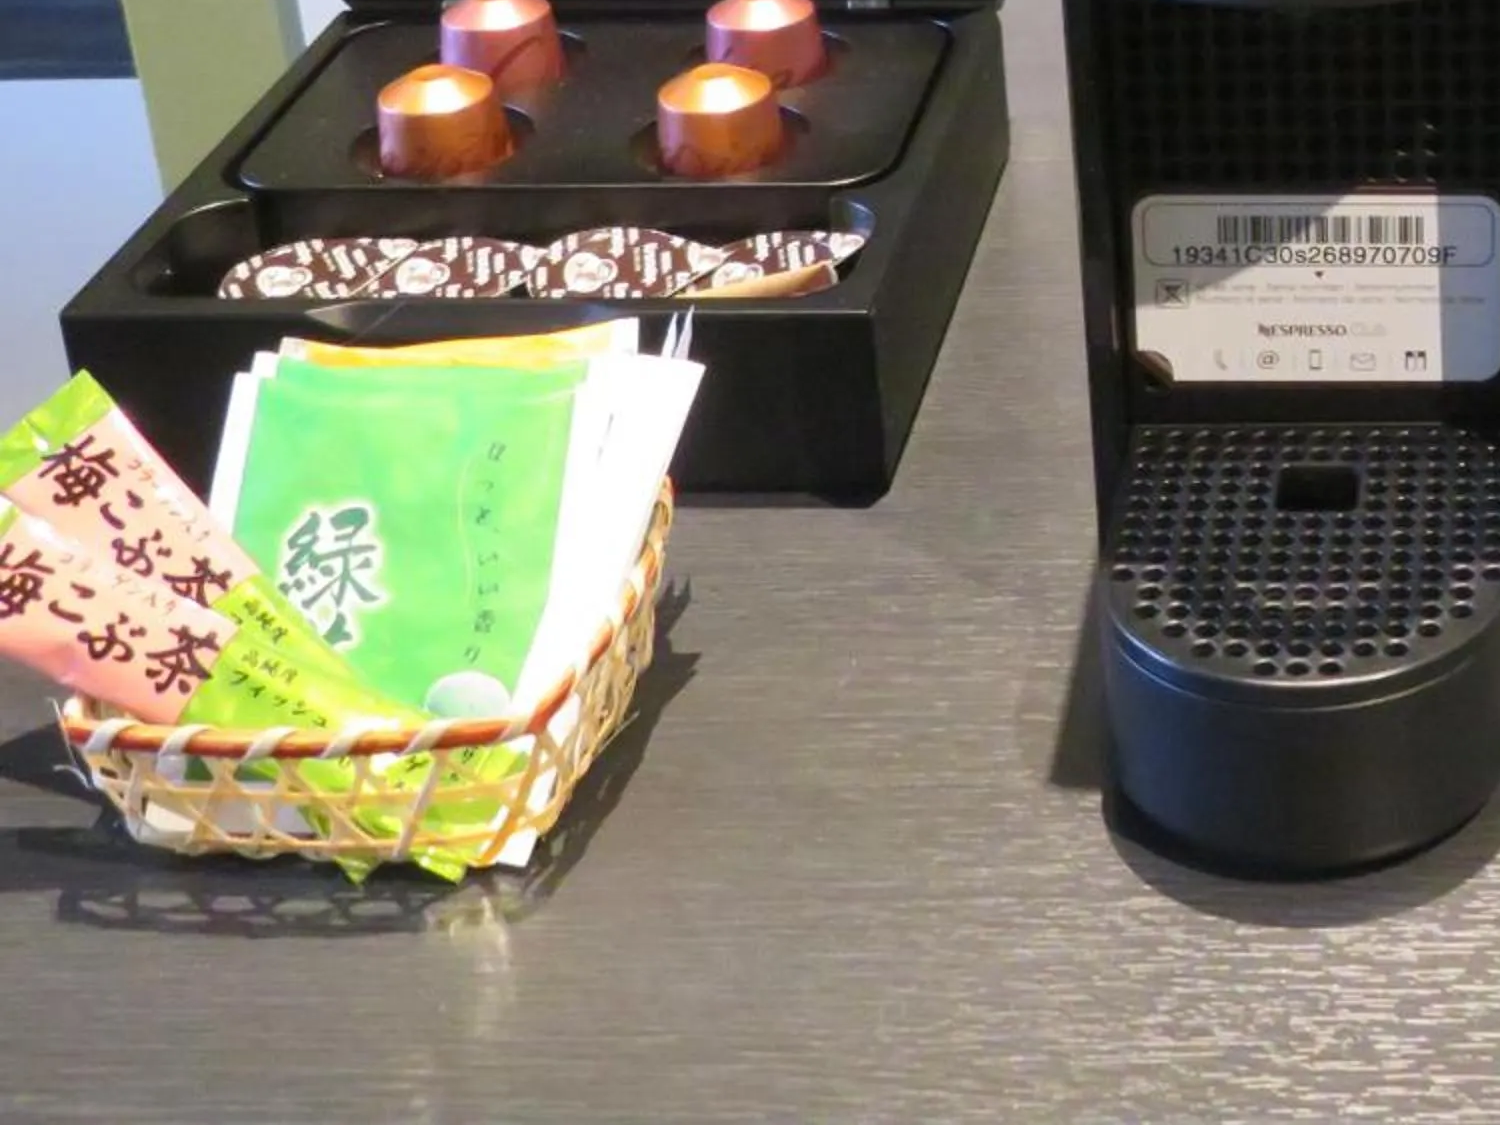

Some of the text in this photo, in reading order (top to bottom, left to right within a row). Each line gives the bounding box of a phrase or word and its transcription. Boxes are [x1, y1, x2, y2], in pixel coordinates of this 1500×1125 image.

[1172, 245, 1458, 266] 19341C30s268970709F
[1257, 323, 1347, 337] NESPRESSO
[37, 434, 234, 608] 梅こぶ茶
[0, 542, 221, 695] 梅こぶ茶
[229, 669, 329, 729] フィッシュ
